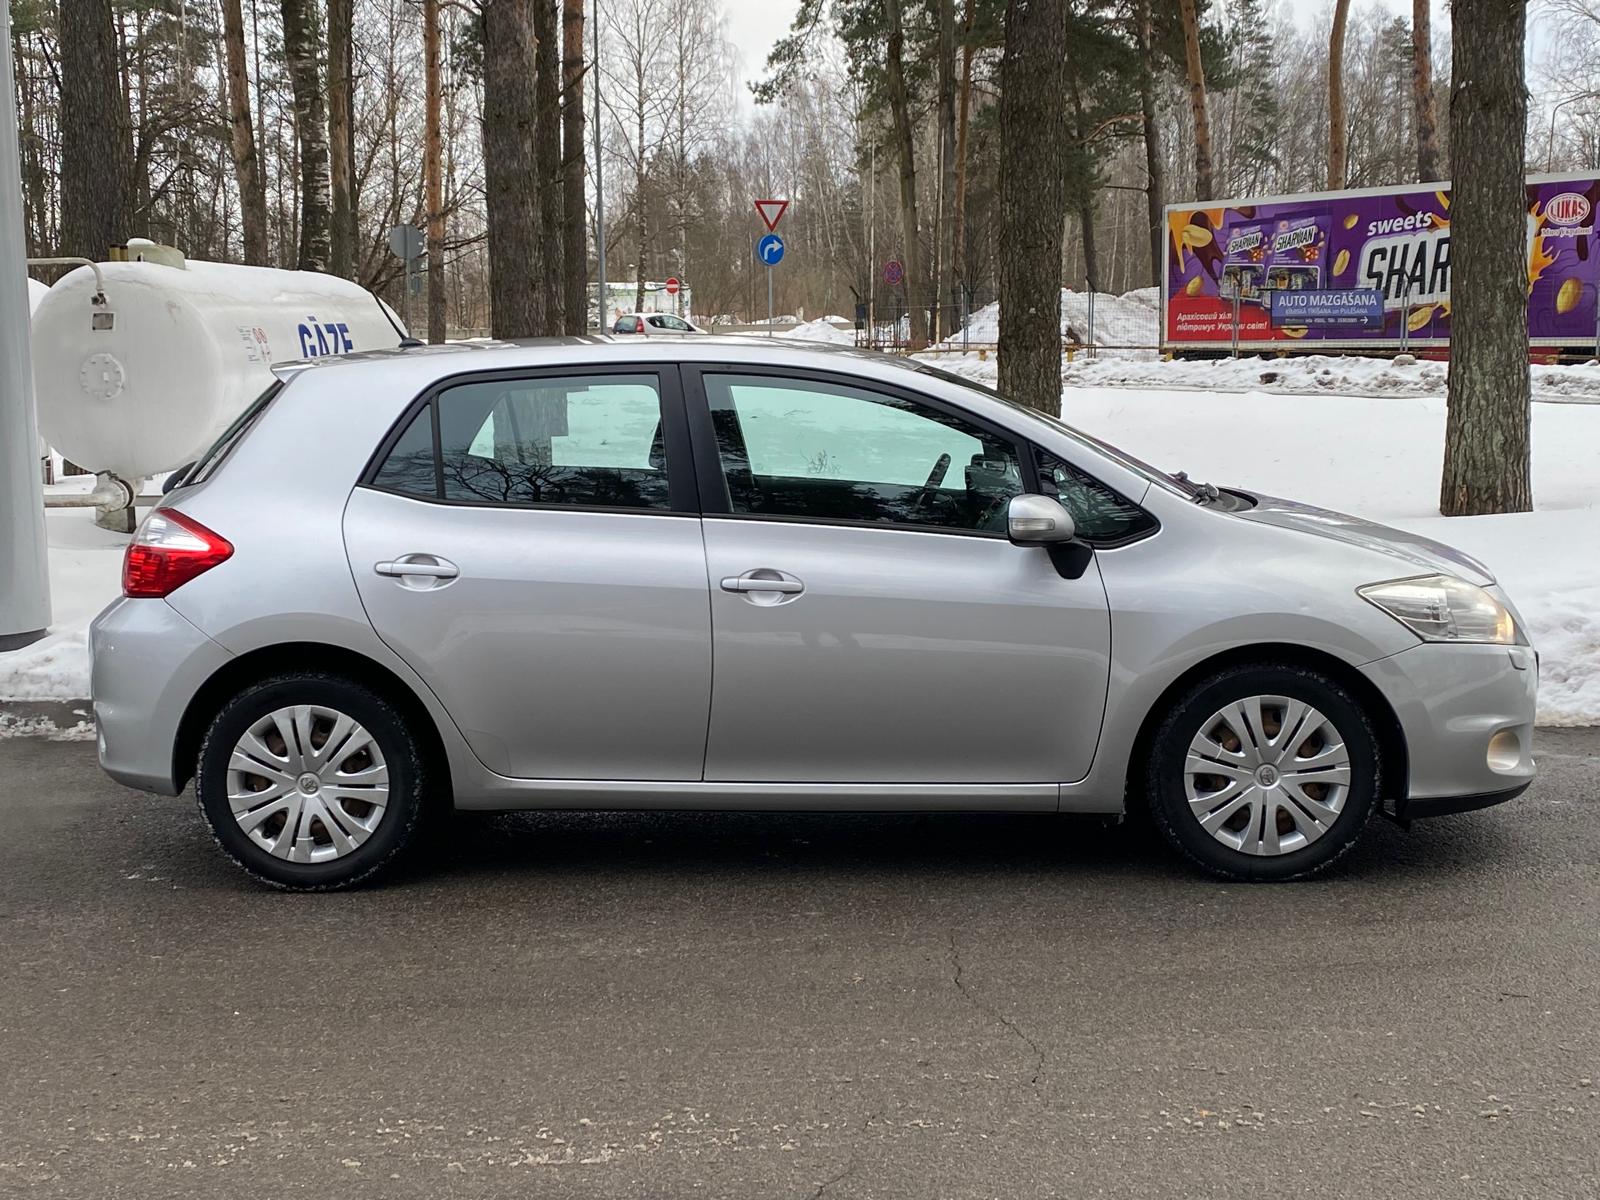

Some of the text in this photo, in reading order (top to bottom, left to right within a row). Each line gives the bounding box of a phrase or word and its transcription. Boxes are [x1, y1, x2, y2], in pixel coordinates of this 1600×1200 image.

[1550, 199, 1586, 219] LUKAS
[1367, 211, 1432, 236] sweets
[1279, 291, 1377, 306] AUTO MAZGĀŠANA
[298, 315, 354, 358] GĀZE
